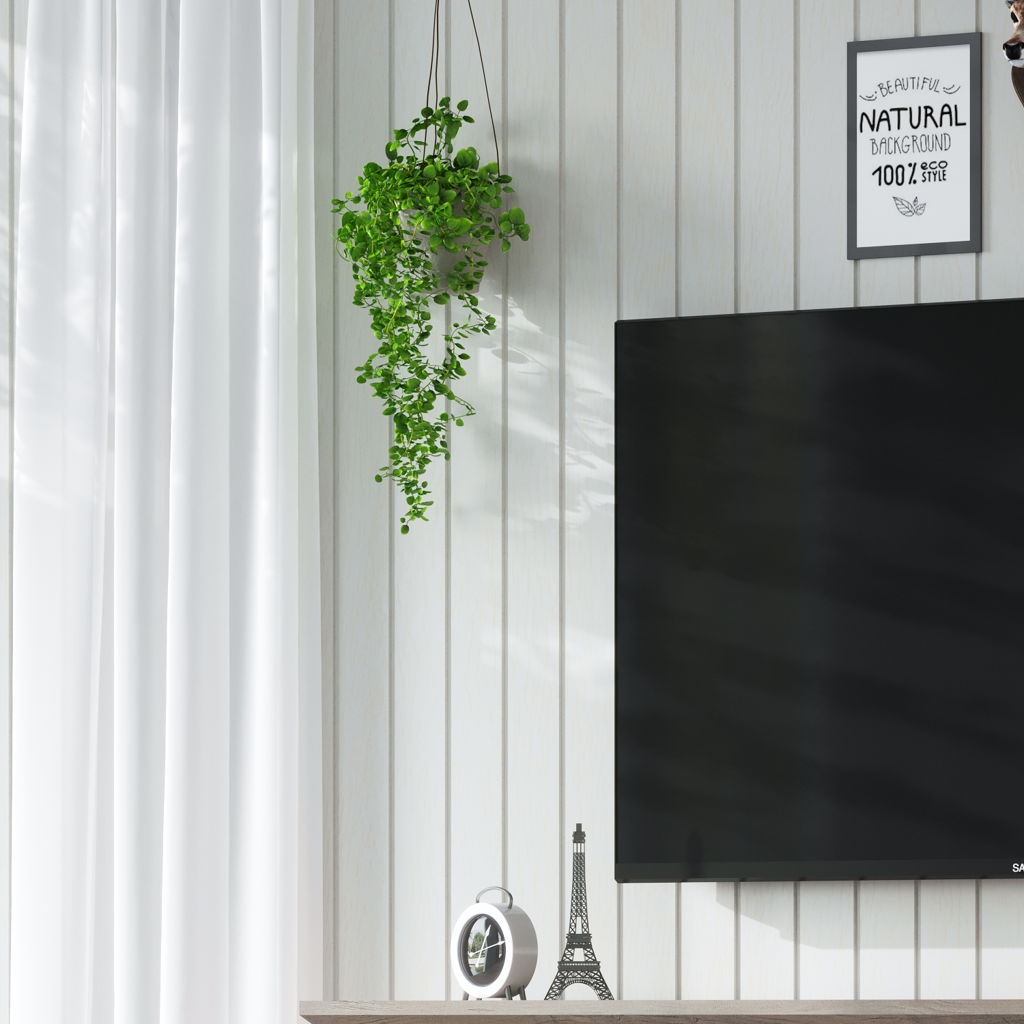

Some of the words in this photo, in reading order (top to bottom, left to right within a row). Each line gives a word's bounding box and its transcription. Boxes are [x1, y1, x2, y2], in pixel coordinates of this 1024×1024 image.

[877, 76, 940, 98] BEAUTIFUL
[859, 103, 967, 133] NATURAL
[869, 132, 952, 156] BACKGROUND
[872, 162, 917, 186] 100%
[921, 169, 947, 183] STYLE
